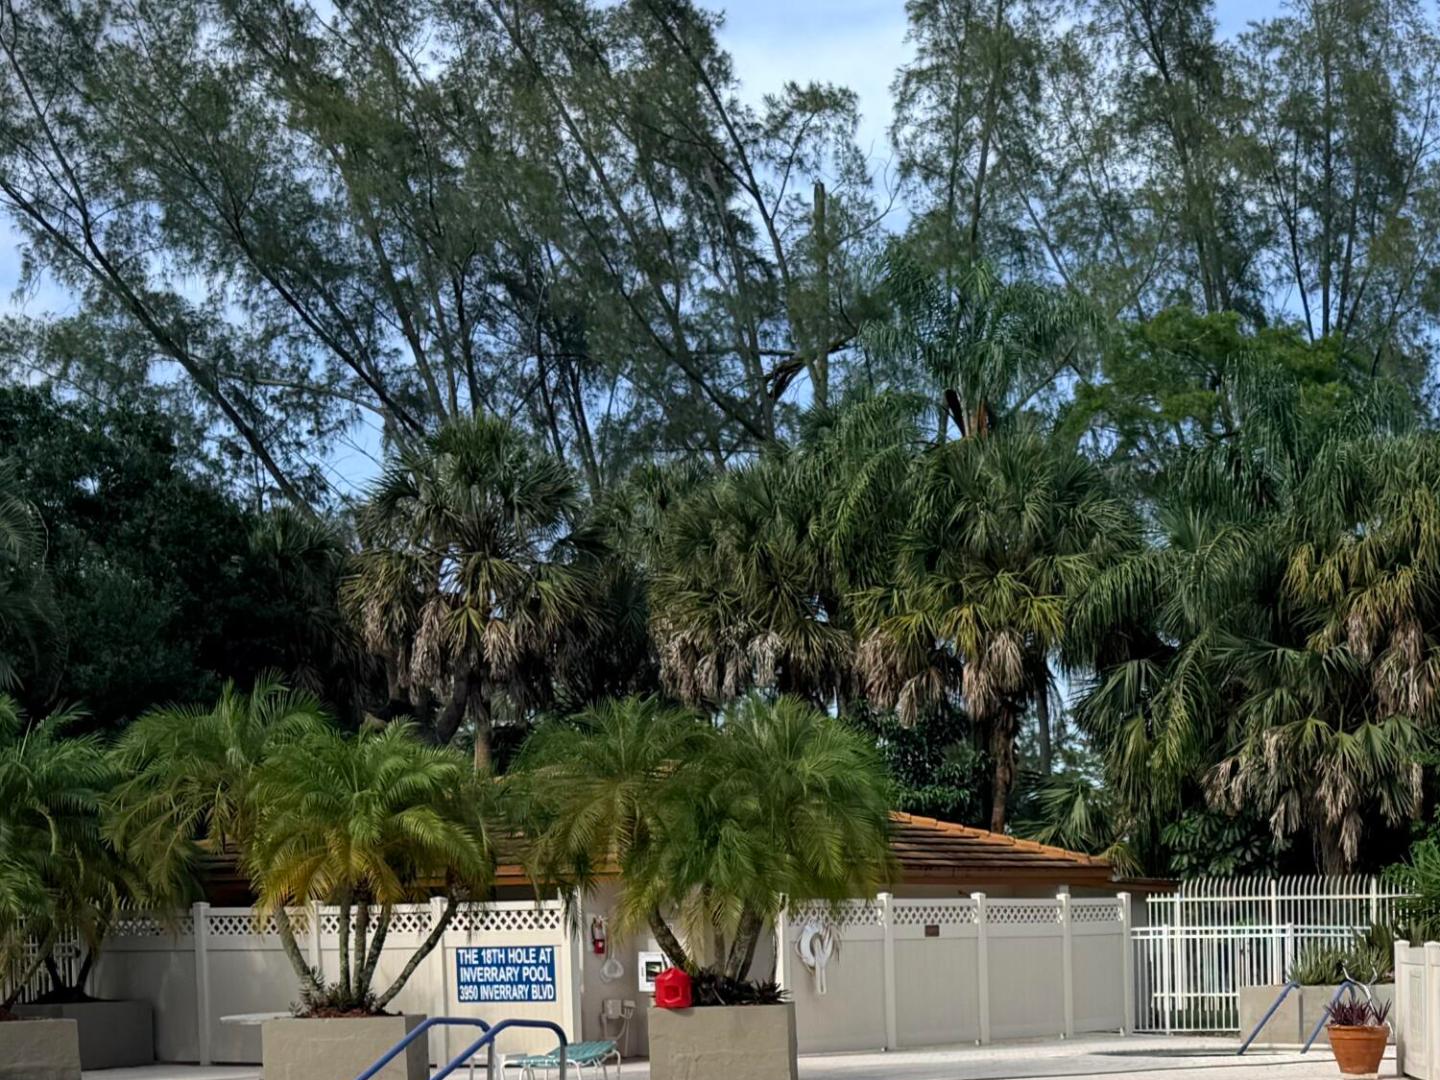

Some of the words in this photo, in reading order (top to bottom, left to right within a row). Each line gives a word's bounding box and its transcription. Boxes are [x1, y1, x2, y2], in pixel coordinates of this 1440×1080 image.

[458, 949, 479, 965] THE
[481, 948, 505, 964] 18TH
[508, 948, 536, 964] HOLE
[539, 948, 552, 964] AT
[460, 966, 520, 982] INVERRARY
[522, 966, 552, 982] POOL
[460, 985, 479, 1001] 3950
[480, 984, 529, 1000] INVERRARY
[531, 984, 554, 1000] BLVD
